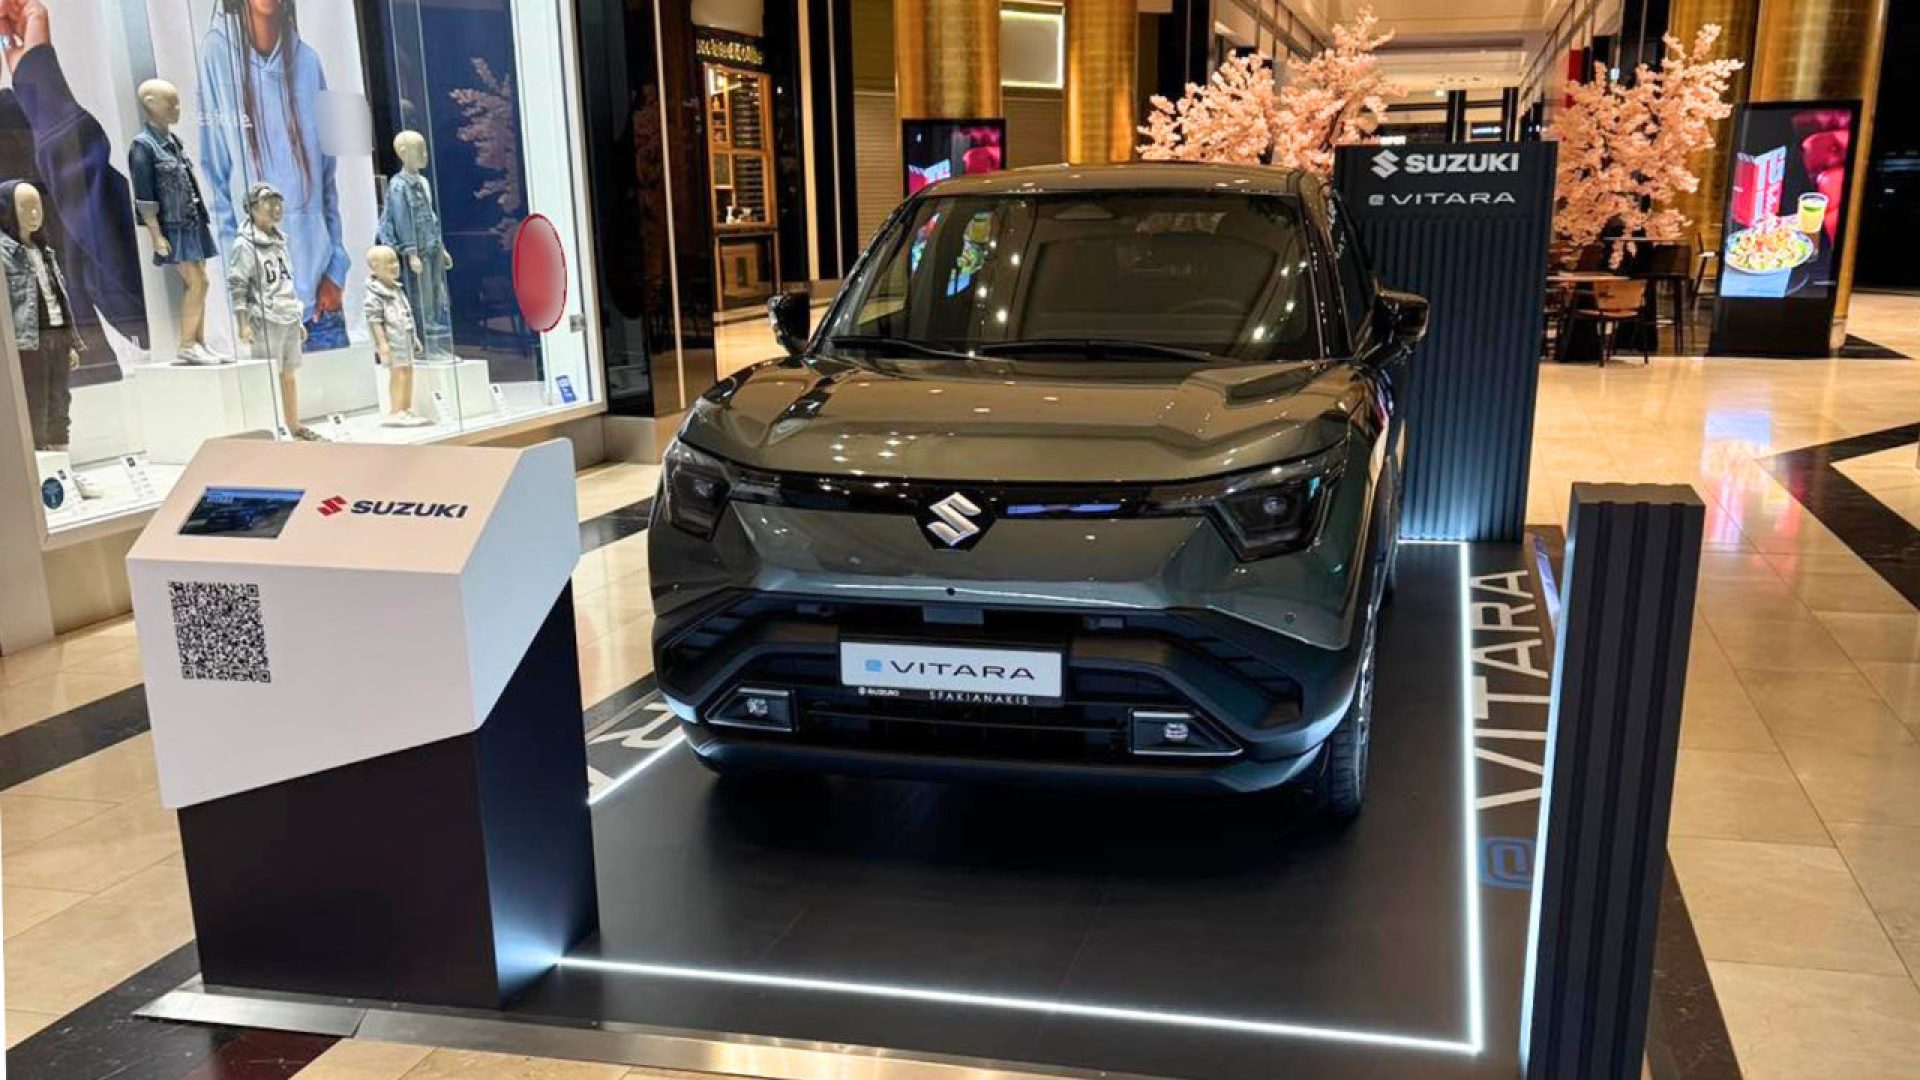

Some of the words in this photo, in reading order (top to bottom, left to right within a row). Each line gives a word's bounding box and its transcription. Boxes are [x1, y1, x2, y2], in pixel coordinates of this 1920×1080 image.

[1404, 152, 1520, 173] SUZUKI
[1391, 191, 1516, 206] VITARA
[264, 257, 292, 283] GA
[350, 500, 469, 519] SUZUKI
[890, 659, 1036, 681] VITARA
[929, 689, 1029, 706] SFAKIANAKIS
[1471, 569, 1553, 811] VITARA
